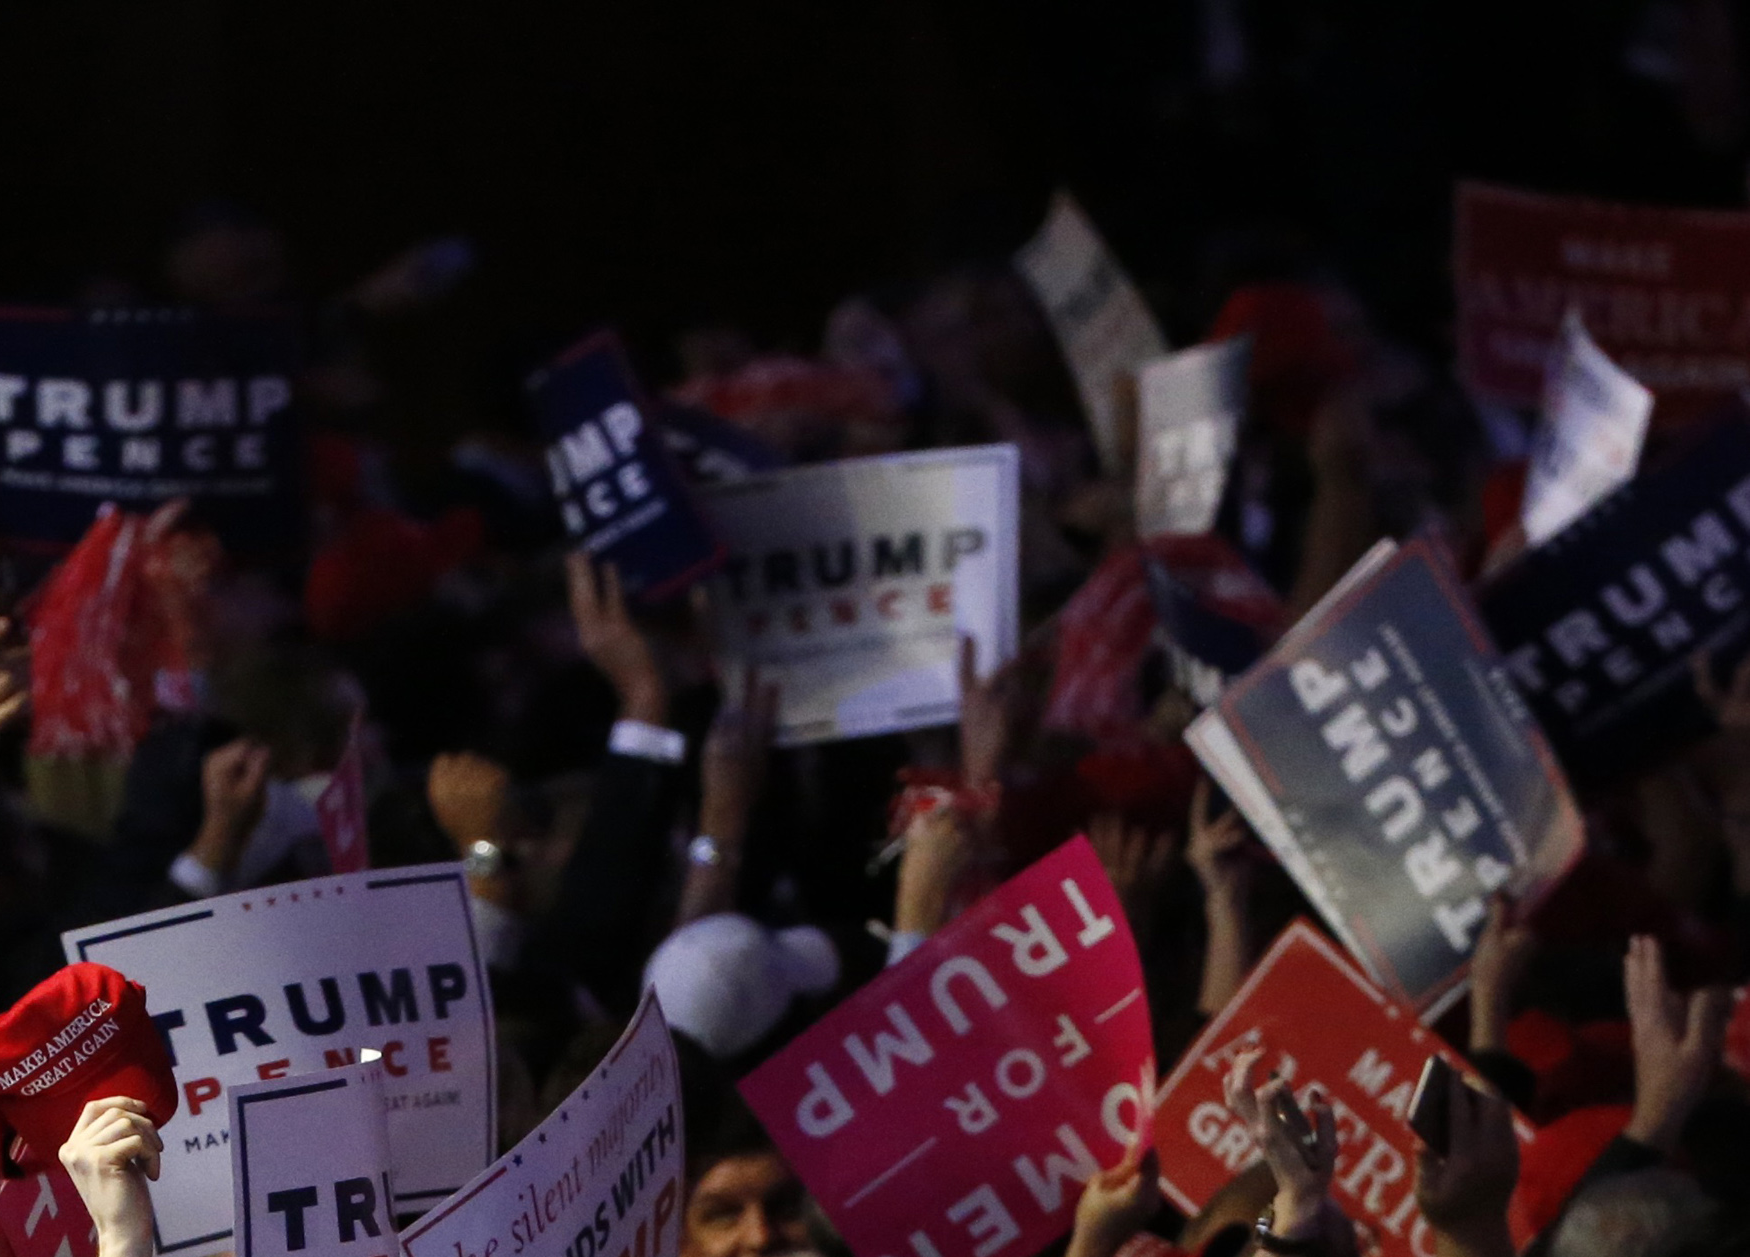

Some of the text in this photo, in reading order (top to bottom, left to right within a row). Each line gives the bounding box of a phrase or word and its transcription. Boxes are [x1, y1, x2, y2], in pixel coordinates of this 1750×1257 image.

[5, 428, 268, 474] PENCE
[725, 527, 986, 602] TRUMP
[1288, 659, 1488, 953] TRUMP
[1350, 645, 1512, 890] PENCE
[20, 1017, 120, 1097] GREAT AGAIN
[46, 997, 113, 1059] AMERICA
[150, 962, 467, 1067] TRUMP
[794, 877, 1116, 1139] TRUMP
[943, 1013, 1093, 1136] FOR
[1348, 1047, 1415, 1122] MA
[513, 1155, 582, 1255] silent
[587, 1050, 668, 1178] majority
[610, 1103, 675, 1221] WITH
